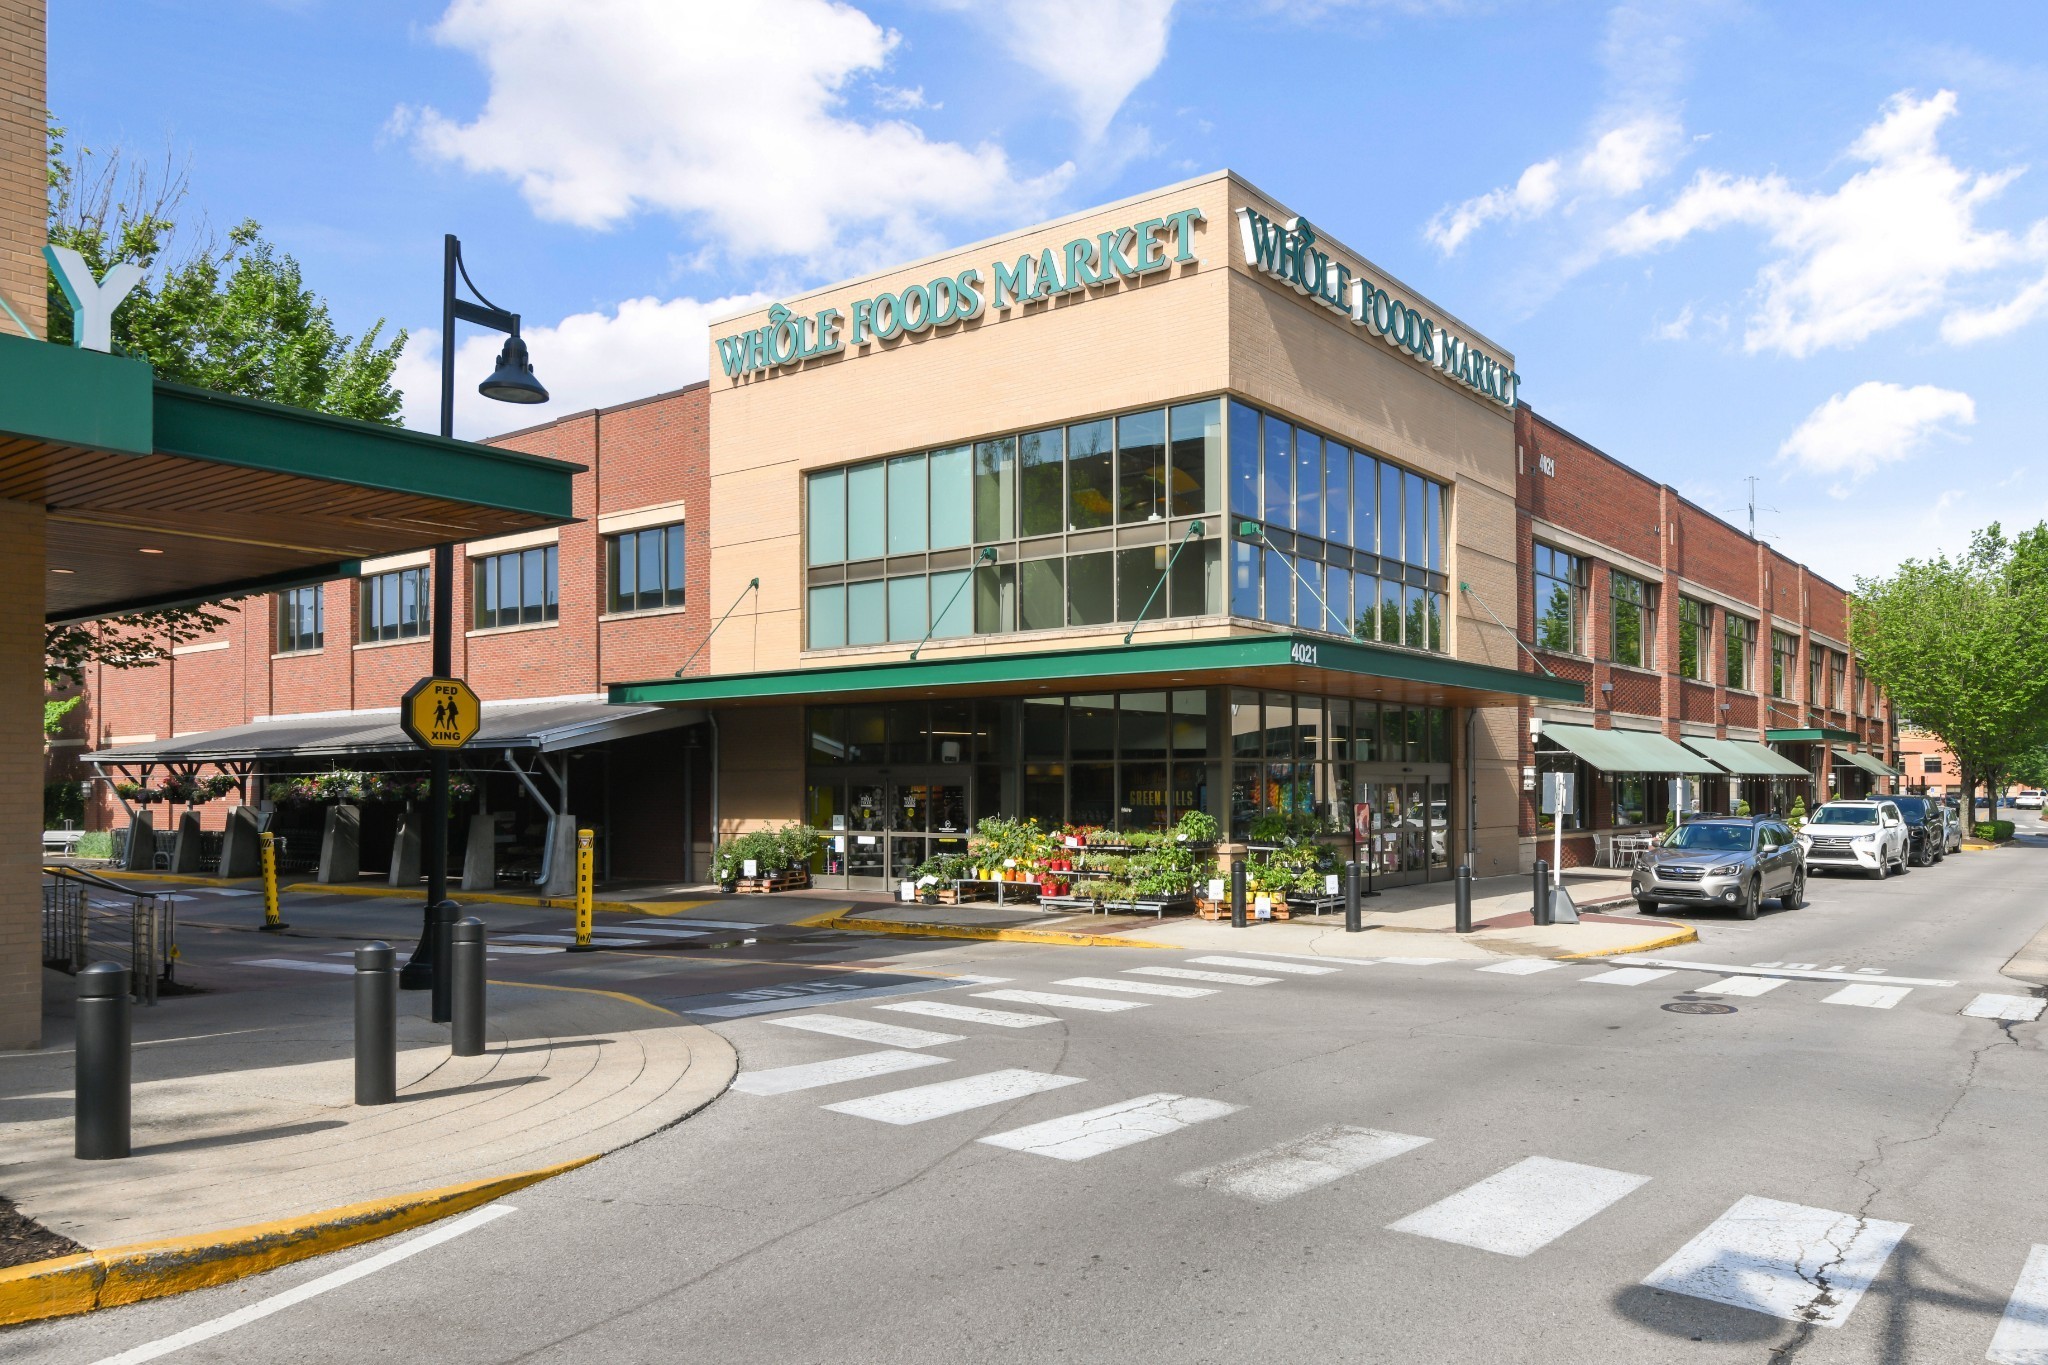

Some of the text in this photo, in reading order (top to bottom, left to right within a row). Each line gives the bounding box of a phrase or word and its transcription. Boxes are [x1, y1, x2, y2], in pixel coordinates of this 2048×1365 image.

[715, 208, 1205, 377] WHOLE FOODS MARKET
[1241, 207, 1521, 410] WHOLE FOODS MARKET
[1291, 642, 1317, 664] 4021
[434, 685, 458, 696] PED
[430, 731, 461, 741] XING
[1129, 790, 1161, 806] GREEN
